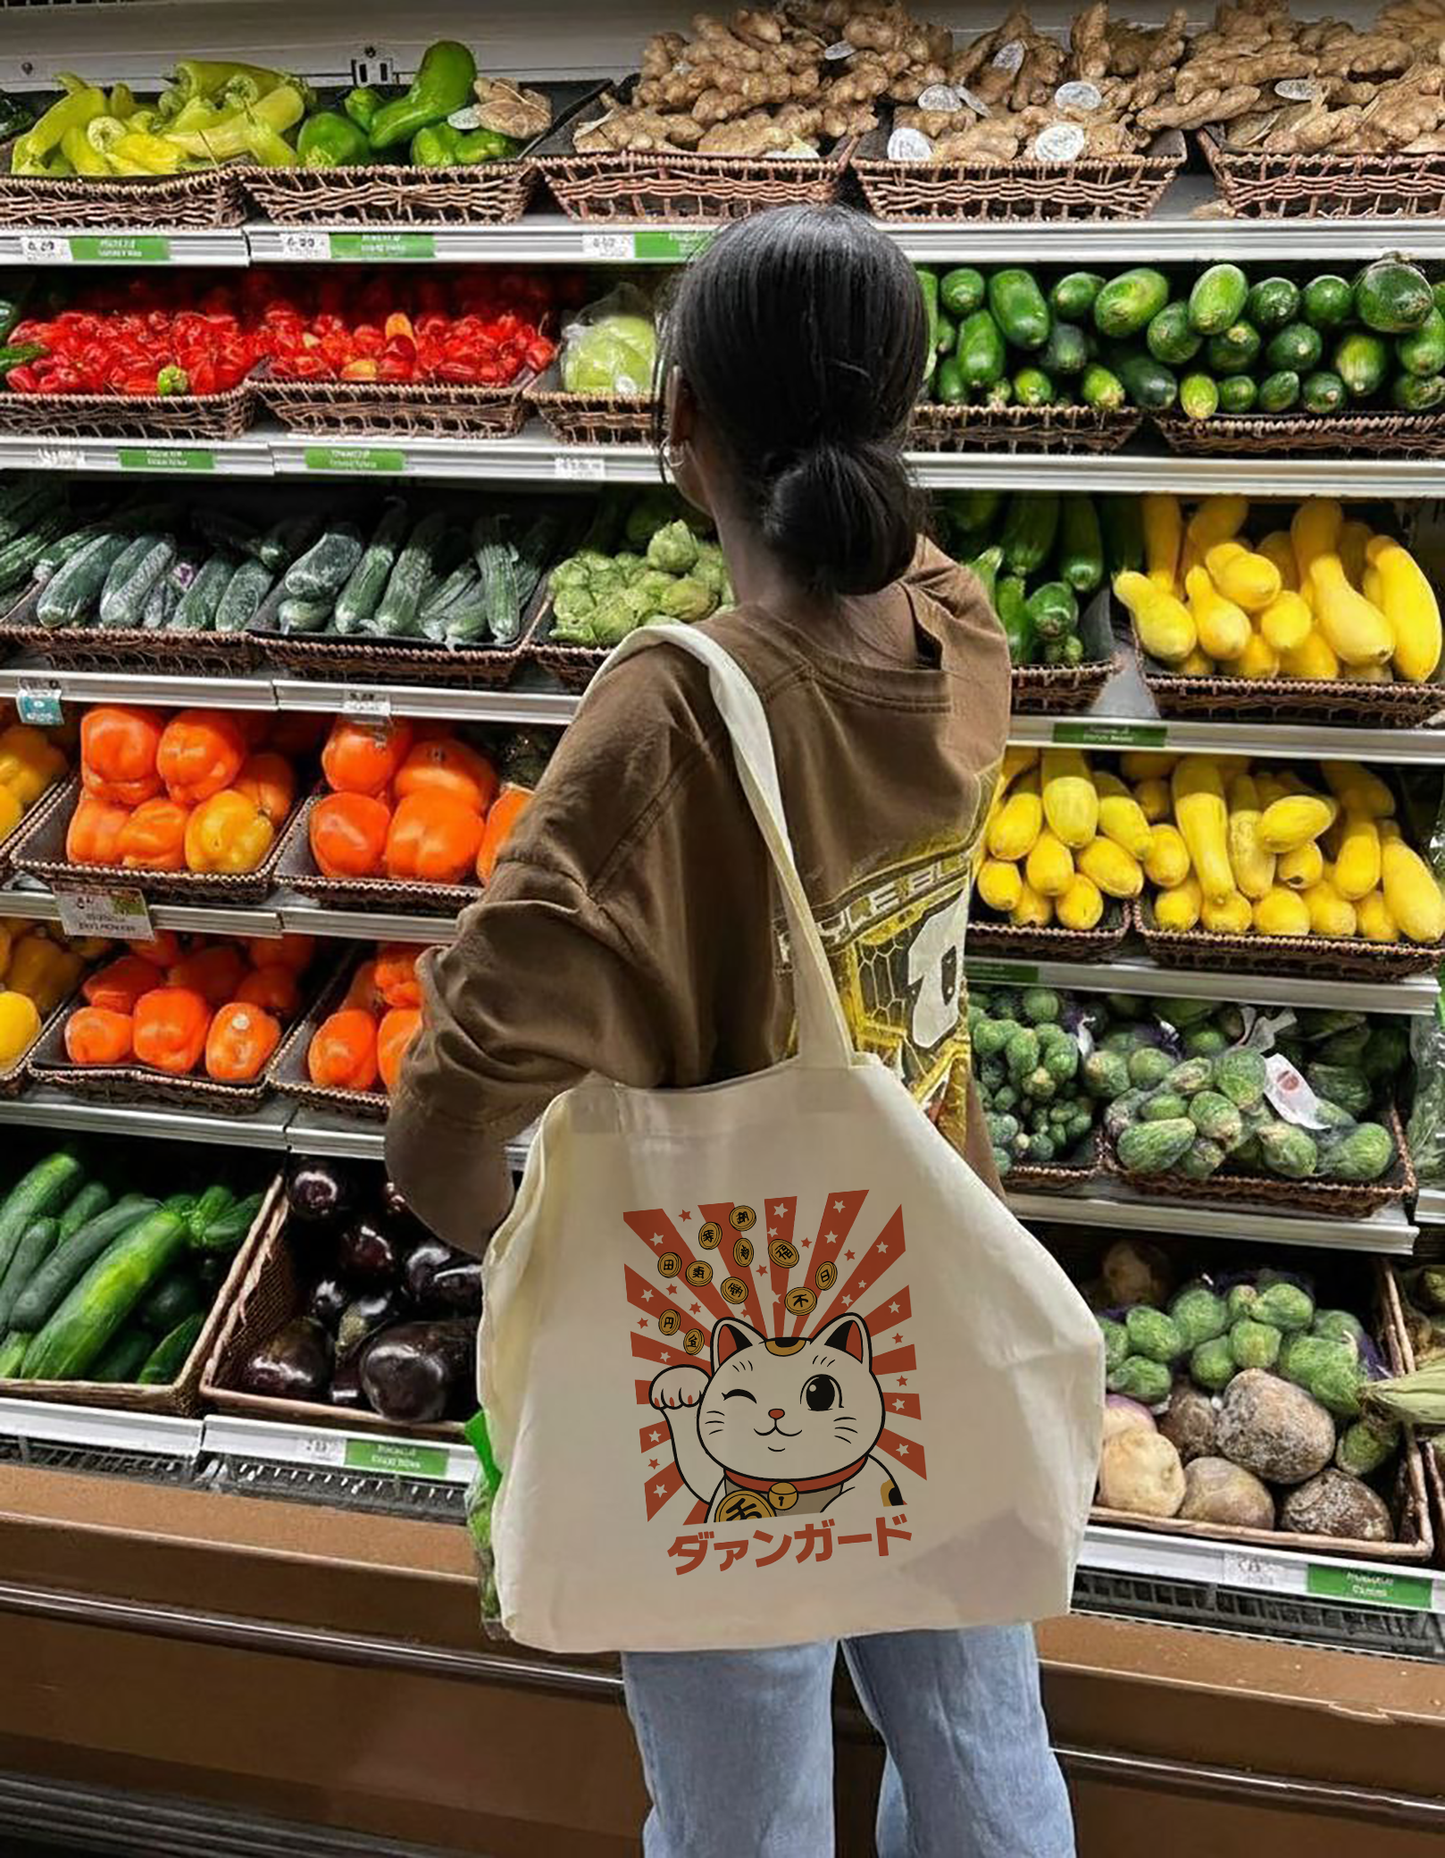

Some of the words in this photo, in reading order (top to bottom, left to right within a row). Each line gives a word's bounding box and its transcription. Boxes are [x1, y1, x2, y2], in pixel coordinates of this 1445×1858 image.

[667, 1513, 912, 1576] ダァンガード
